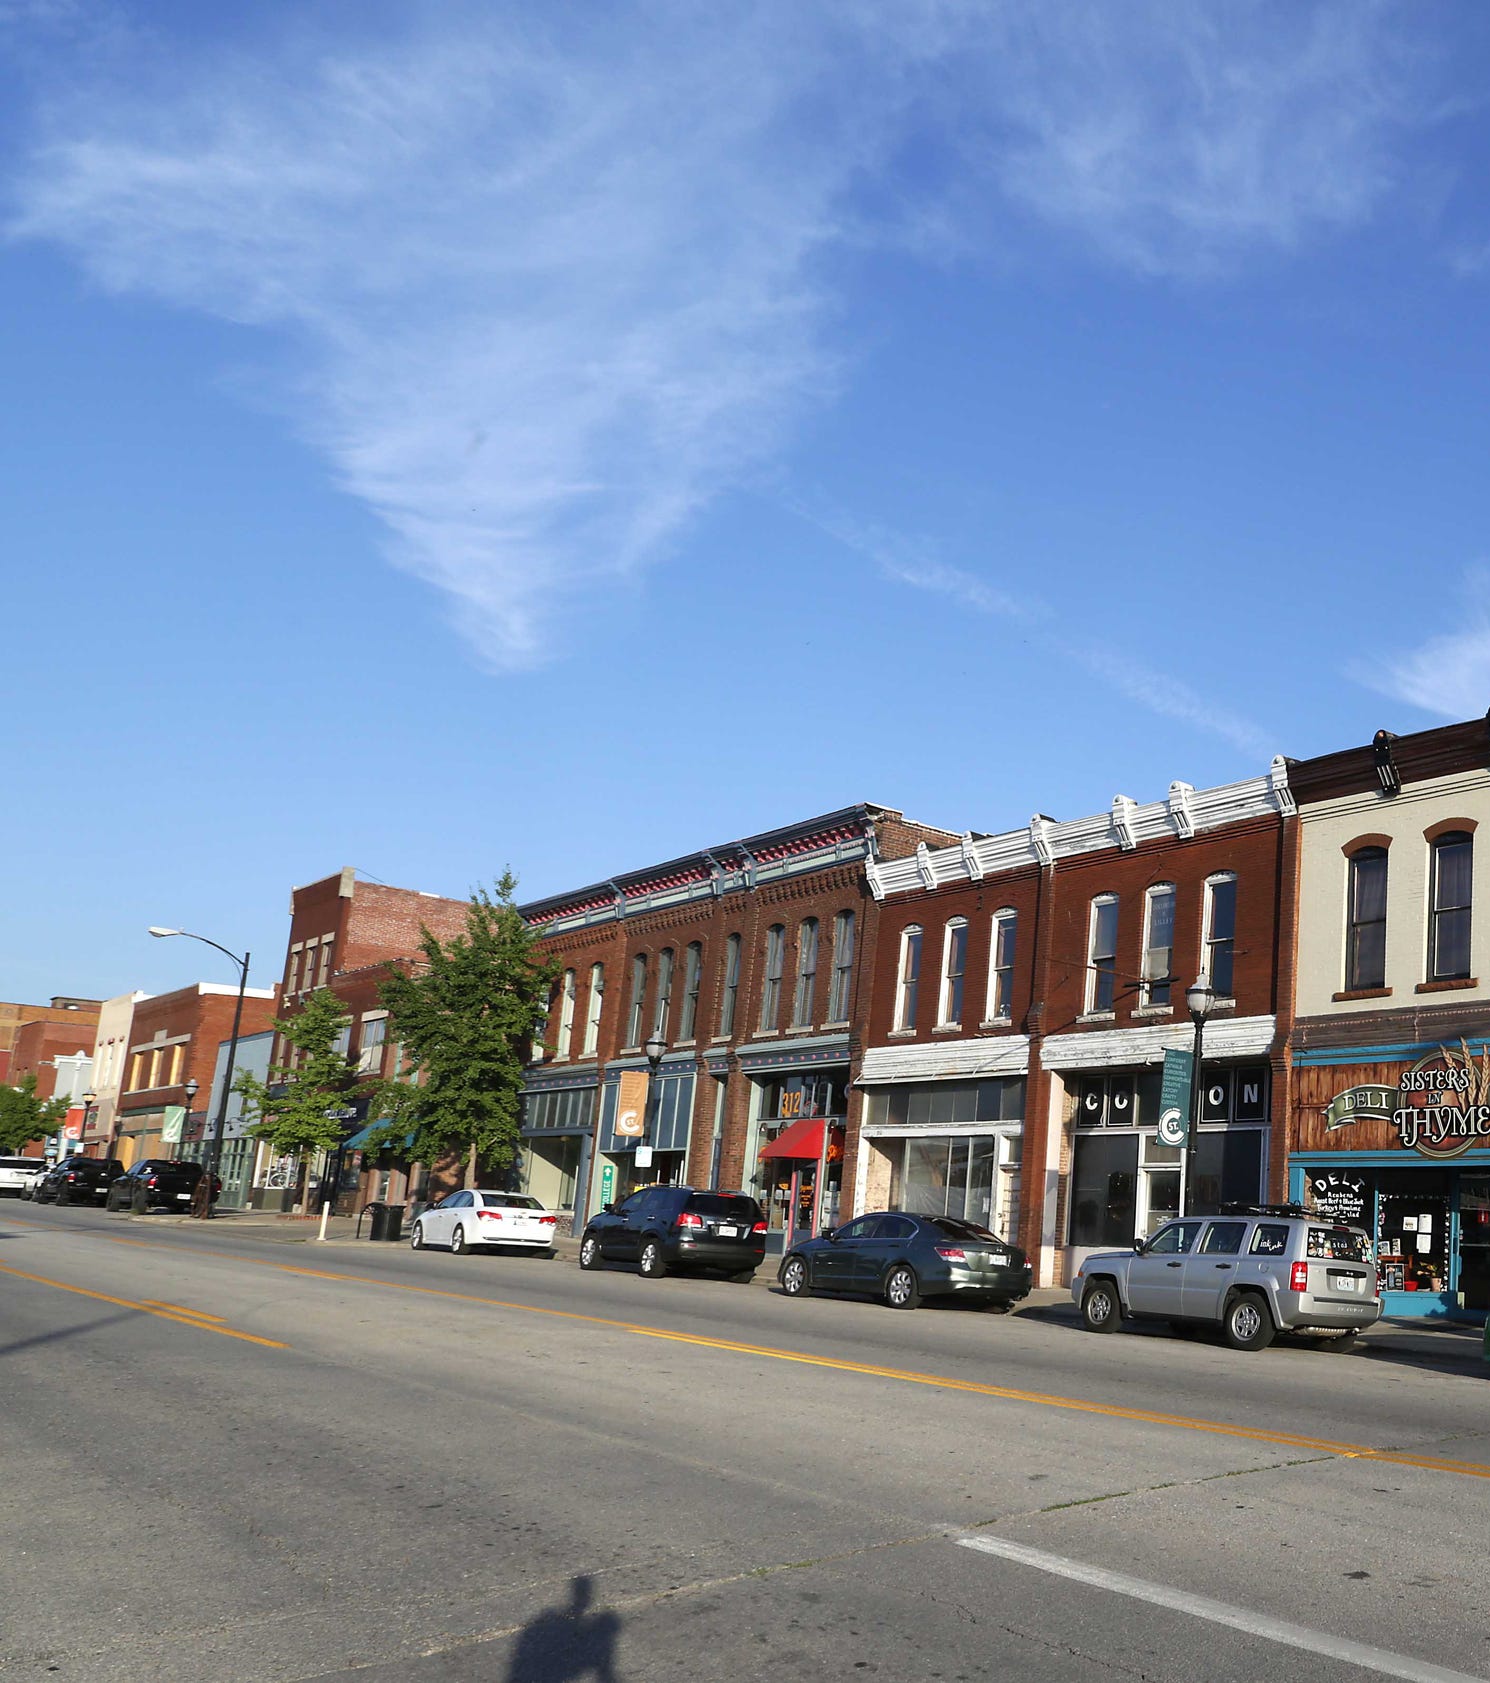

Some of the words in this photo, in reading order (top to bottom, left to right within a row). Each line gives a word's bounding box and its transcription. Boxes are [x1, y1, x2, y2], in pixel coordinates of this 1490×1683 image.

[1400, 1067, 1470, 1092] SISTERS
[781, 1091, 801, 1114] 312
[1343, 1091, 1389, 1112] DELI
[1427, 1091, 1443, 1105] IN
[1168, 1121, 1180, 1131] ST.
[1315, 1171, 1366, 1193] DELI
